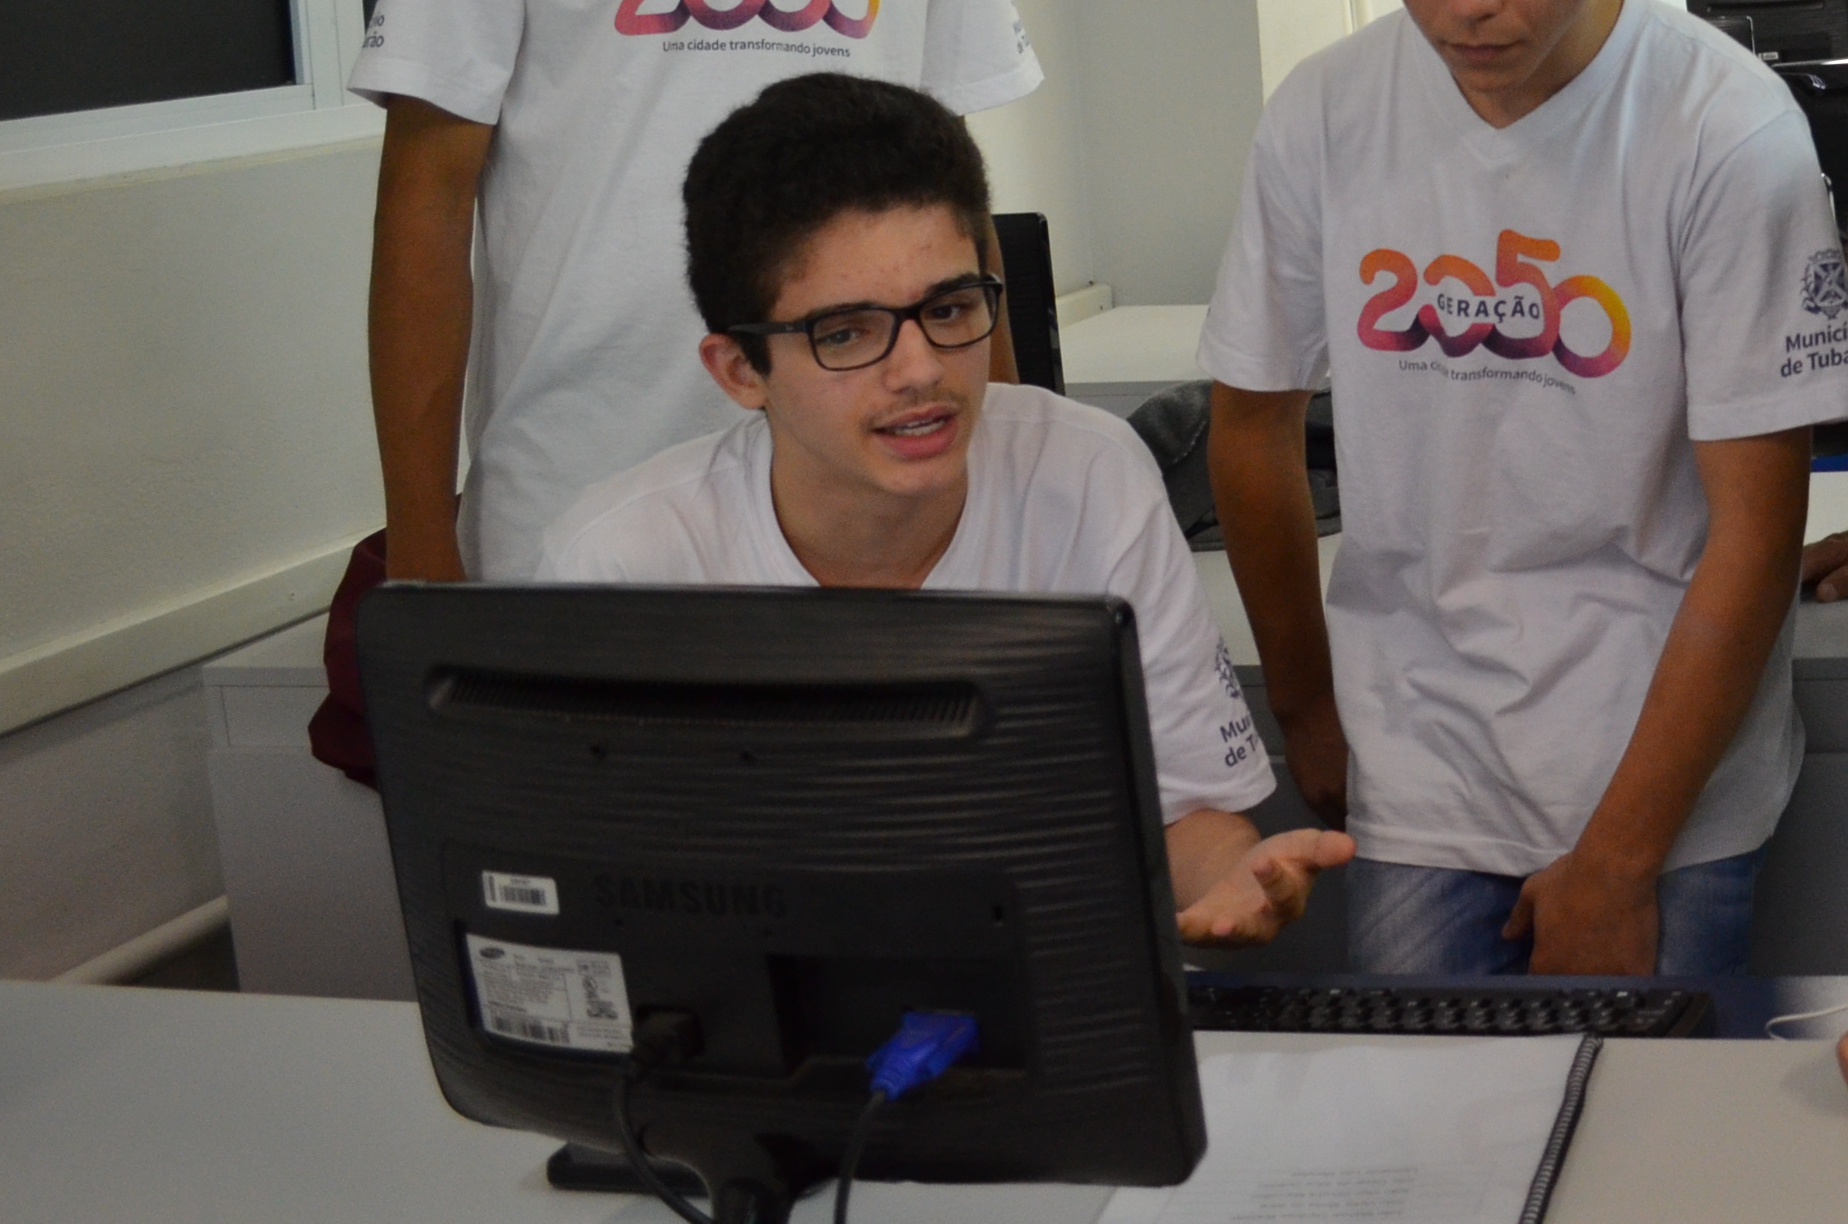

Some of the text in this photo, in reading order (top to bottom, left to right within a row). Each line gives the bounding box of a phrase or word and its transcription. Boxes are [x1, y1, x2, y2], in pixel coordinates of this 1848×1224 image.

[687, 39, 727, 51] cidade
[729, 38, 811, 54] transformando
[812, 44, 851, 58] jovens
[1438, 293, 1540, 323] GERAÇÃO
[1399, 360, 1428, 371] Uma
[1451, 366, 1543, 383] transformando
[1543, 377, 1577, 395] jovens
[1780, 358, 1803, 378] de
[1225, 746, 1247, 767] de
[594, 873, 787, 918] SAMSUNG
